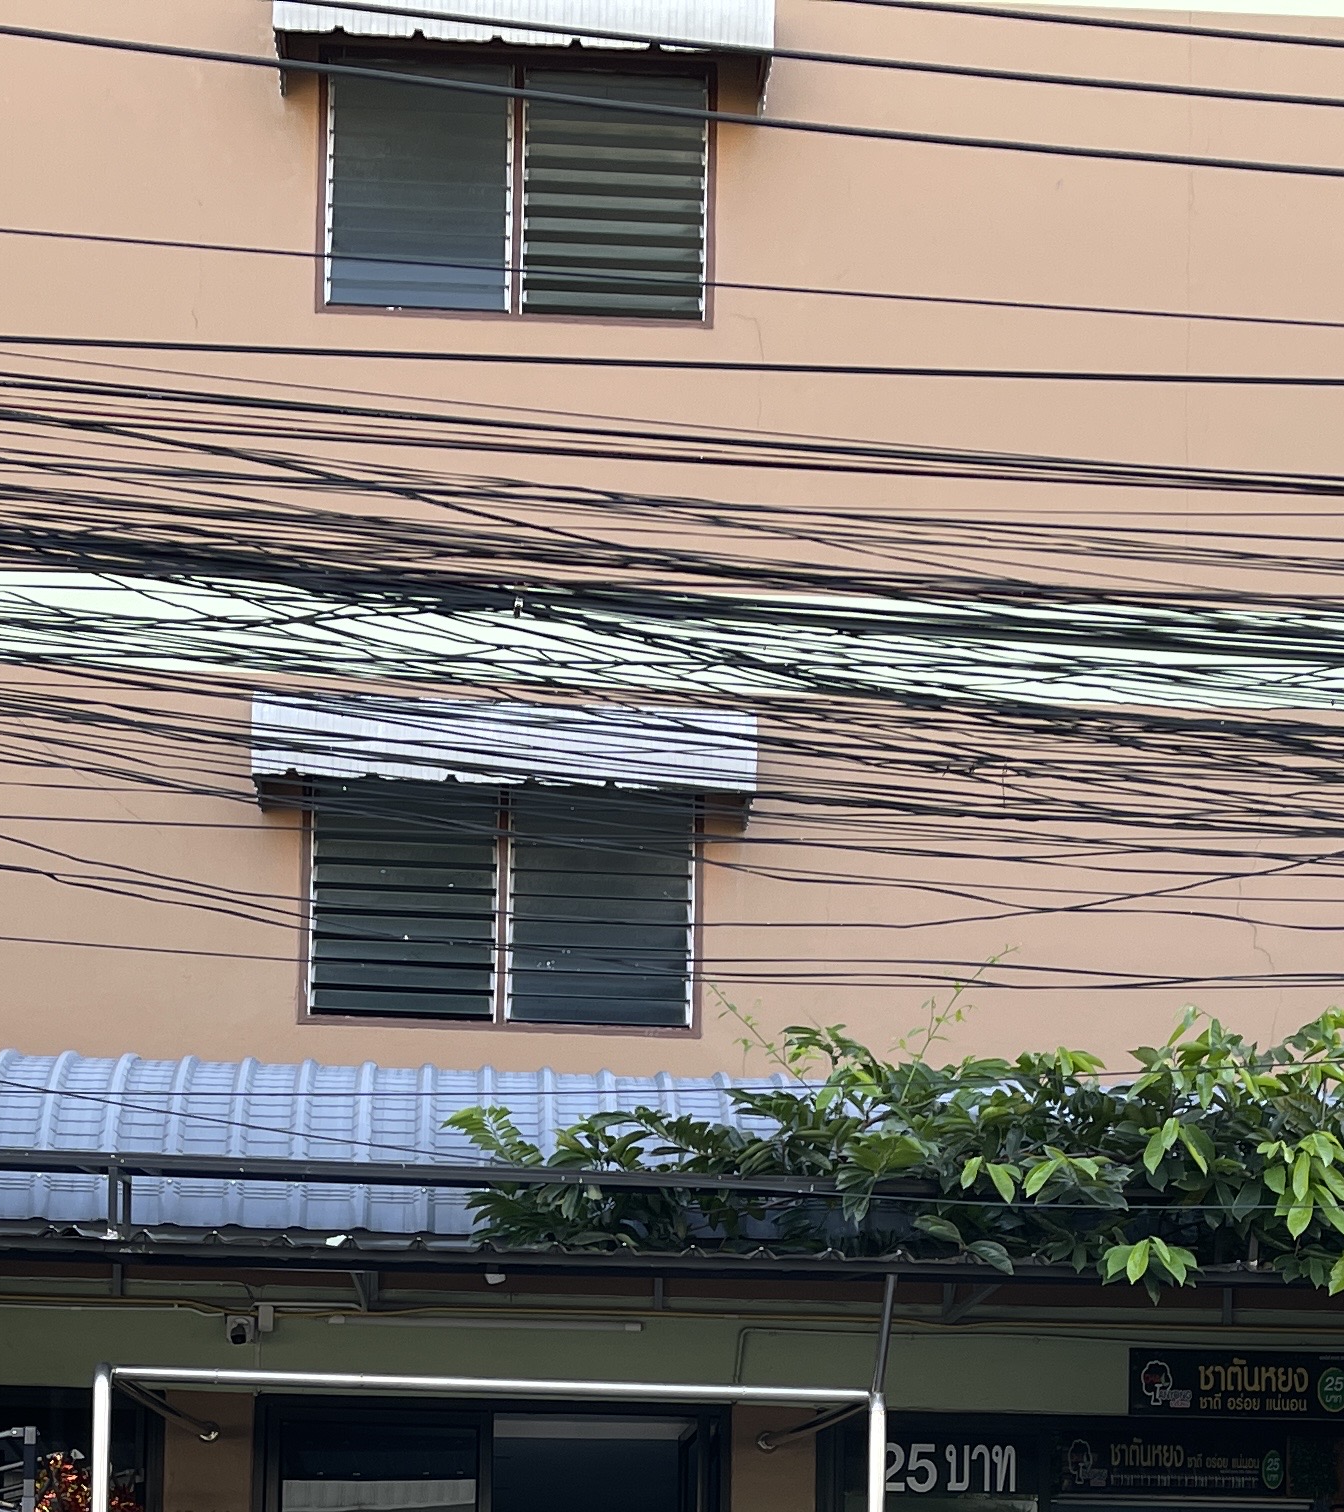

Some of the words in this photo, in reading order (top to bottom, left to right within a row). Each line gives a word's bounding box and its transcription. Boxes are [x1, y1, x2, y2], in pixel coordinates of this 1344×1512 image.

[1198, 1357, 1310, 1393] ชาตันหยง
[1324, 1376, 1344, 1392] 25
[1227, 1394, 1260, 1412] อร่อย
[1266, 1394, 1308, 1412] แน่นอน
[885, 1442, 938, 1493] 25
[945, 1443, 1016, 1493] บาท
[1266, 1457, 1281, 1471] 25
